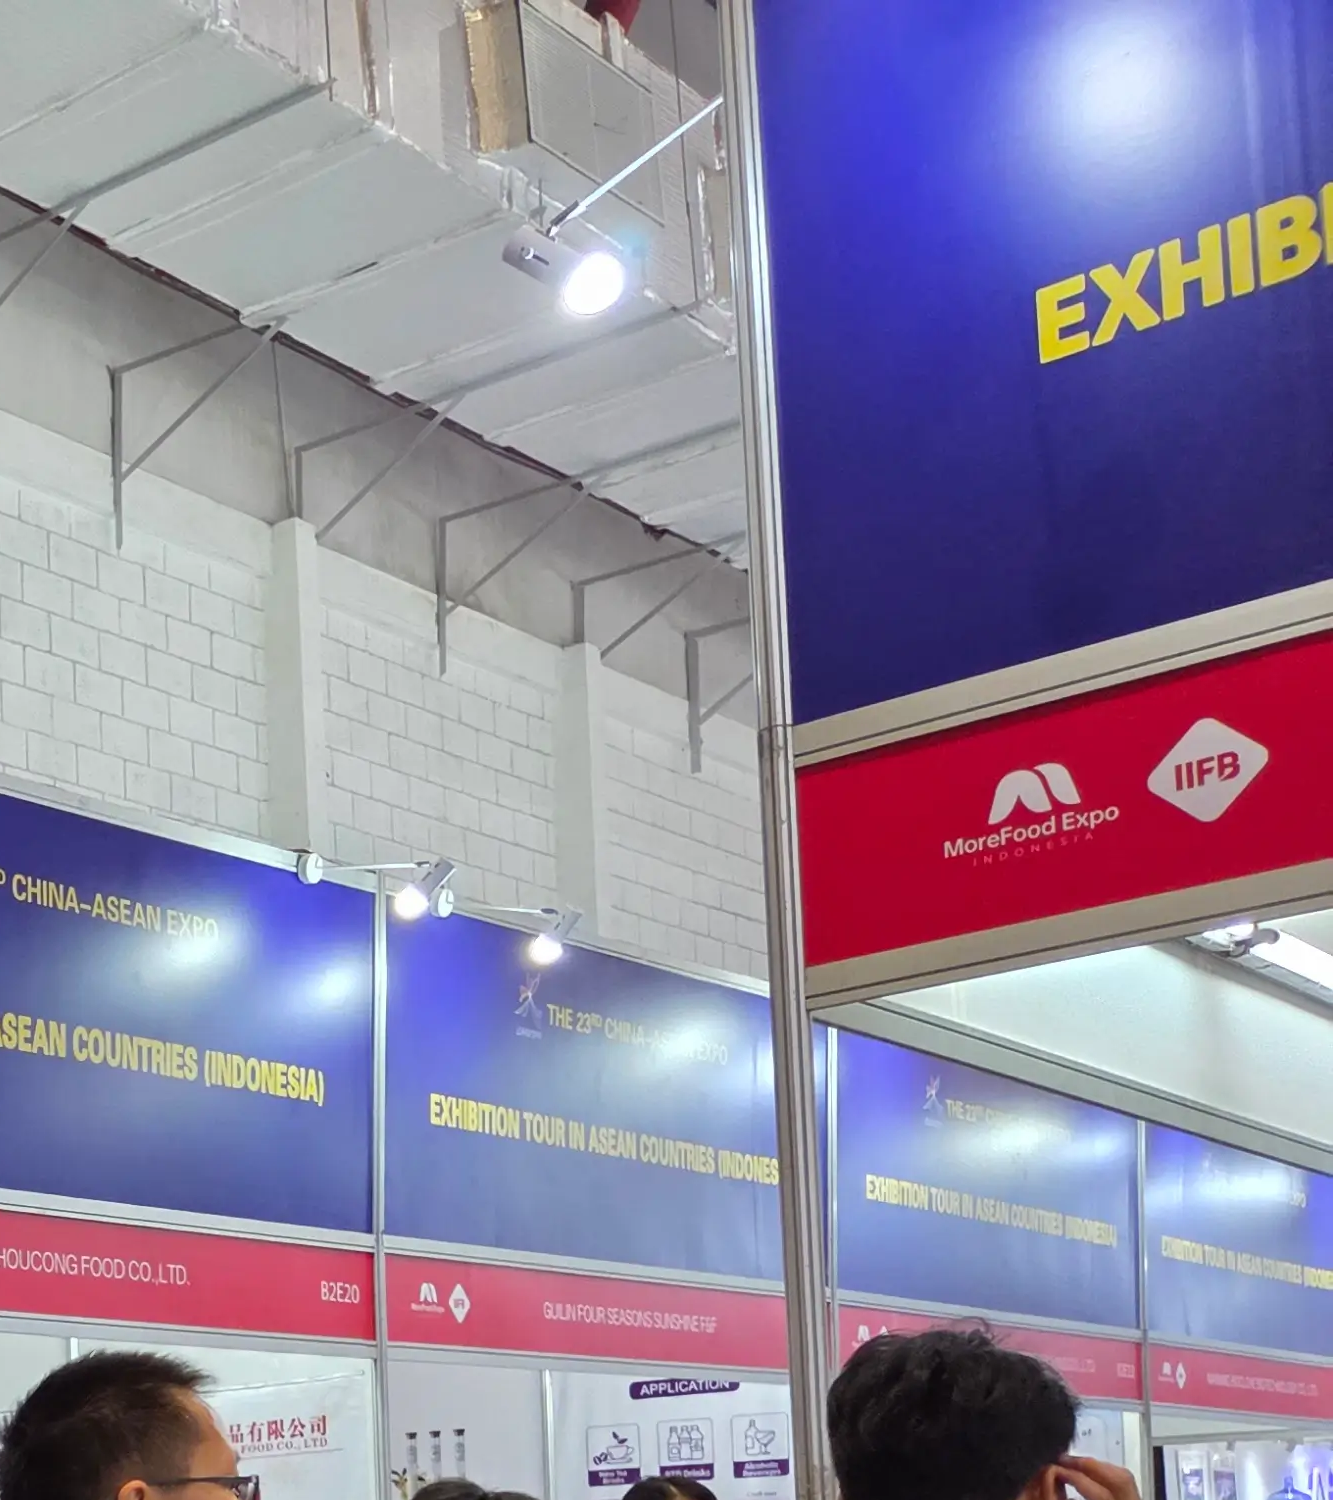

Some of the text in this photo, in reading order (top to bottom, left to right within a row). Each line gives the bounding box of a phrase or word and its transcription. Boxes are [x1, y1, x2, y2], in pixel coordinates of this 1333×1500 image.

[1035, 180, 1333, 365] EXHIB
[1174, 750, 1240, 791] IIFB
[943, 805, 1120, 859] MoreFood Expo
[973, 832, 1094, 867] INDONESIA
[12, 874, 162, 934] CHINA-ASEAN
[167, 908, 220, 943] EXPO
[546, 1003, 574, 1031] THE
[73, 1026, 199, 1082] COUNTRIES
[204, 1049, 325, 1107] (INDONESIA)
[430, 1093, 779, 1186] EXHIBITION TOUR IN ASEAN COUNTRIES (INDONES
[866, 1174, 929, 1211] EXHIBITION
[930, 1187, 961, 1216] TOUR
[975, 1197, 1010, 1226] ASEAN
[81, 1255, 126, 1280] FOOD
[320, 1279, 360, 1304] B2E20
[543, 1301, 577, 1323] GUILIN
[577, 1305, 606, 1325] FOUR
[607, 1308, 653, 1328] SEASONS
[654, 1312, 699, 1332] SUNSHINE
[640, 1379, 731, 1396] APPLICATION
[240, 1443, 274, 1454] FOOD
[304, 1438, 328, 1449] LTD
